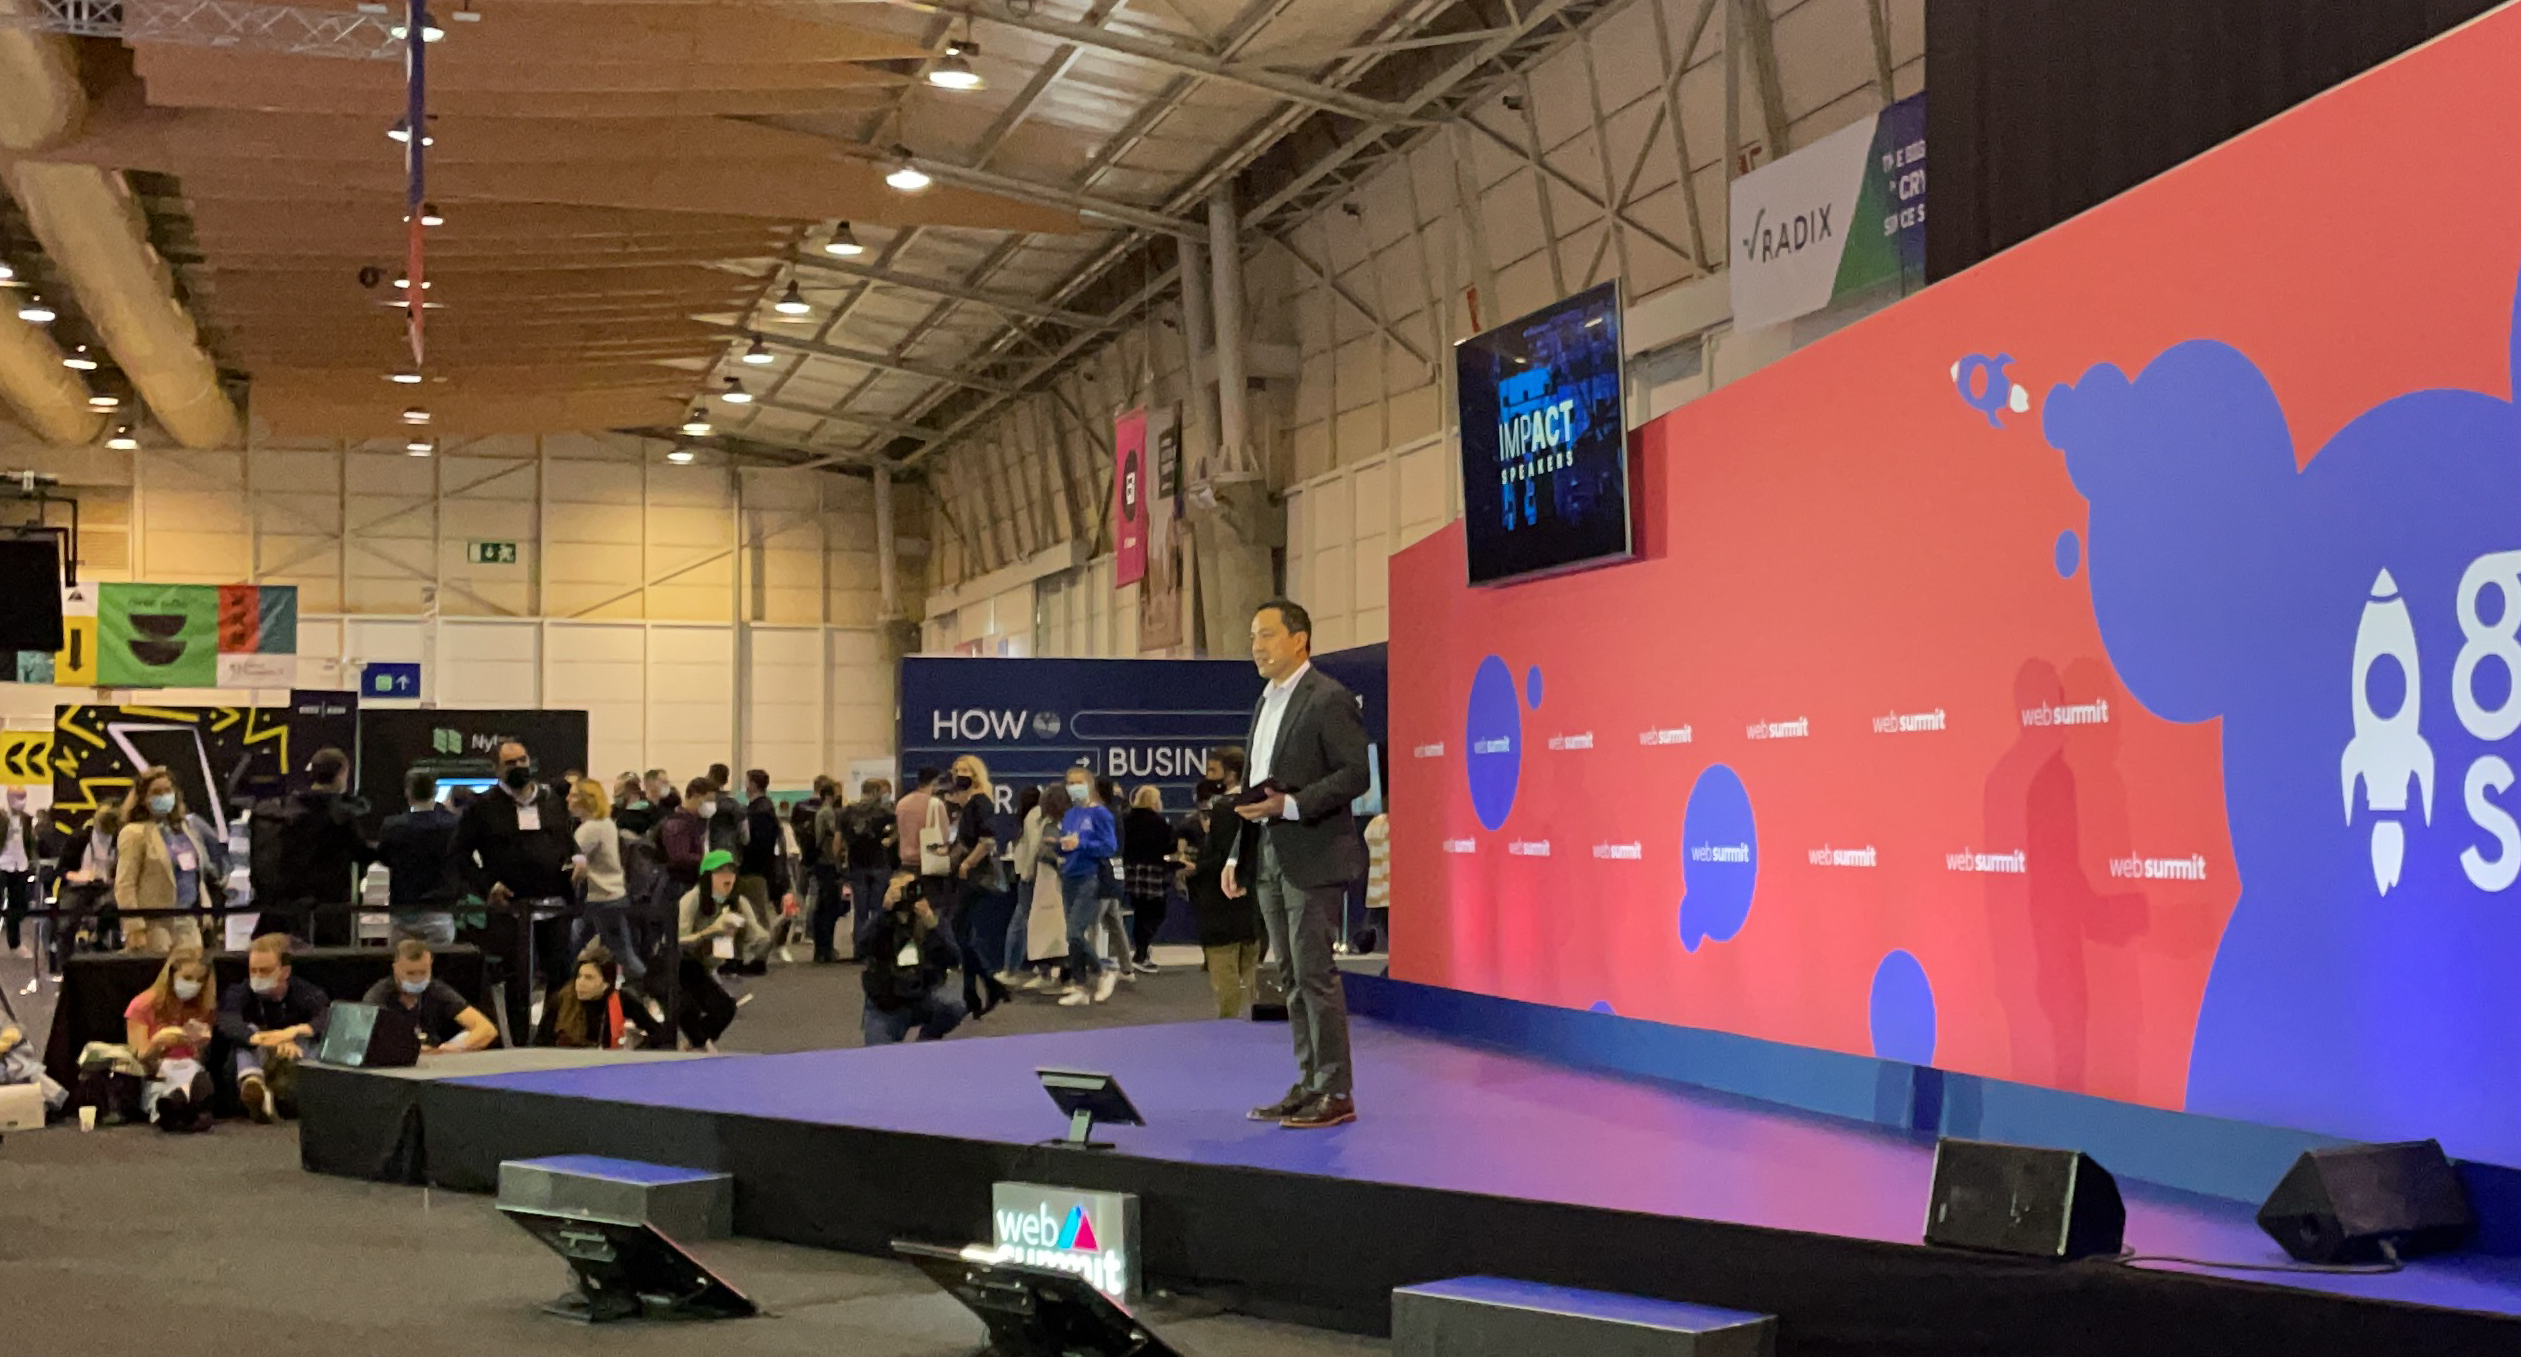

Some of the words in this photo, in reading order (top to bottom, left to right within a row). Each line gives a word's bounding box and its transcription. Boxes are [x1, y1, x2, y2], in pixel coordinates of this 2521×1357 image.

[1499, 399, 1574, 462] IMPACT
[1501, 450, 1574, 485] SPEAKERS
[933, 709, 1027, 740] HOW
[471, 733, 498, 753] Nyl
[1108, 746, 1214, 776] BUSIN
[996, 1200, 1059, 1248] web
